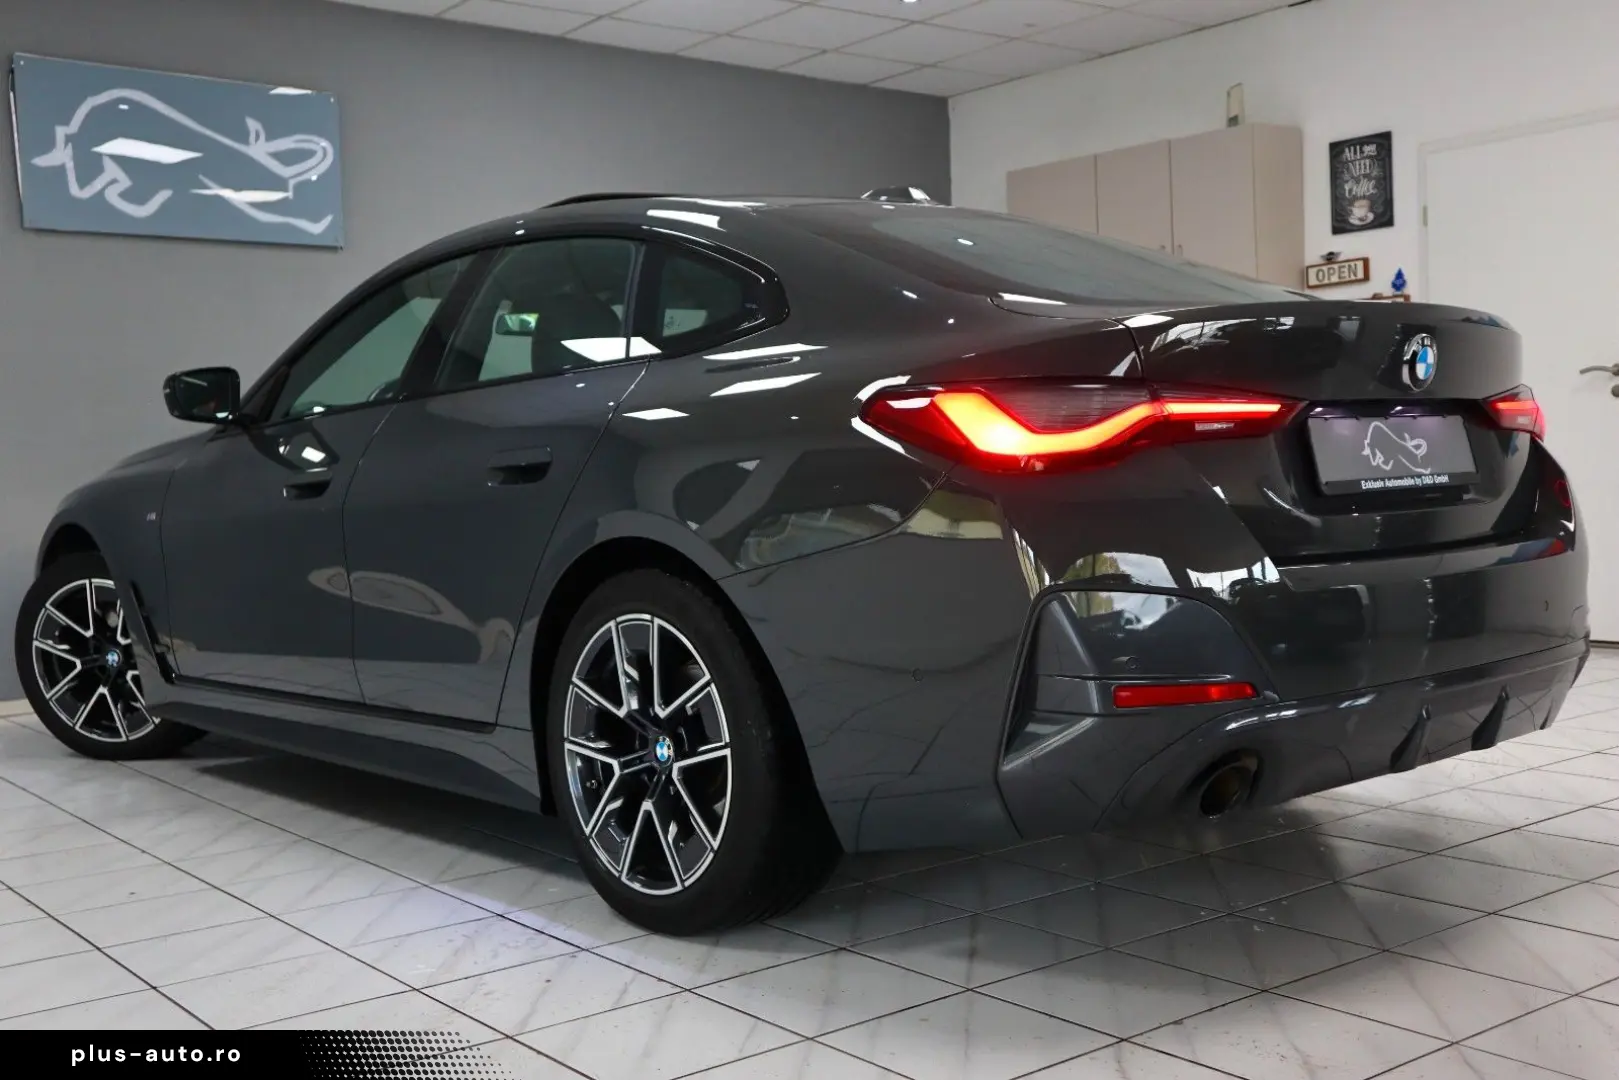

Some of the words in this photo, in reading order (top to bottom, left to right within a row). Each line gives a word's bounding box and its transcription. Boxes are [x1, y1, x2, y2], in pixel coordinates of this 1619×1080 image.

[1343, 144, 1361, 161] ALL
[1348, 159, 1374, 177] NEED
[1315, 263, 1358, 283] OPEN
[1385, 477, 1414, 487] Automobile
[1414, 476, 1422, 487] by
[1434, 474, 1449, 484] GmbH
